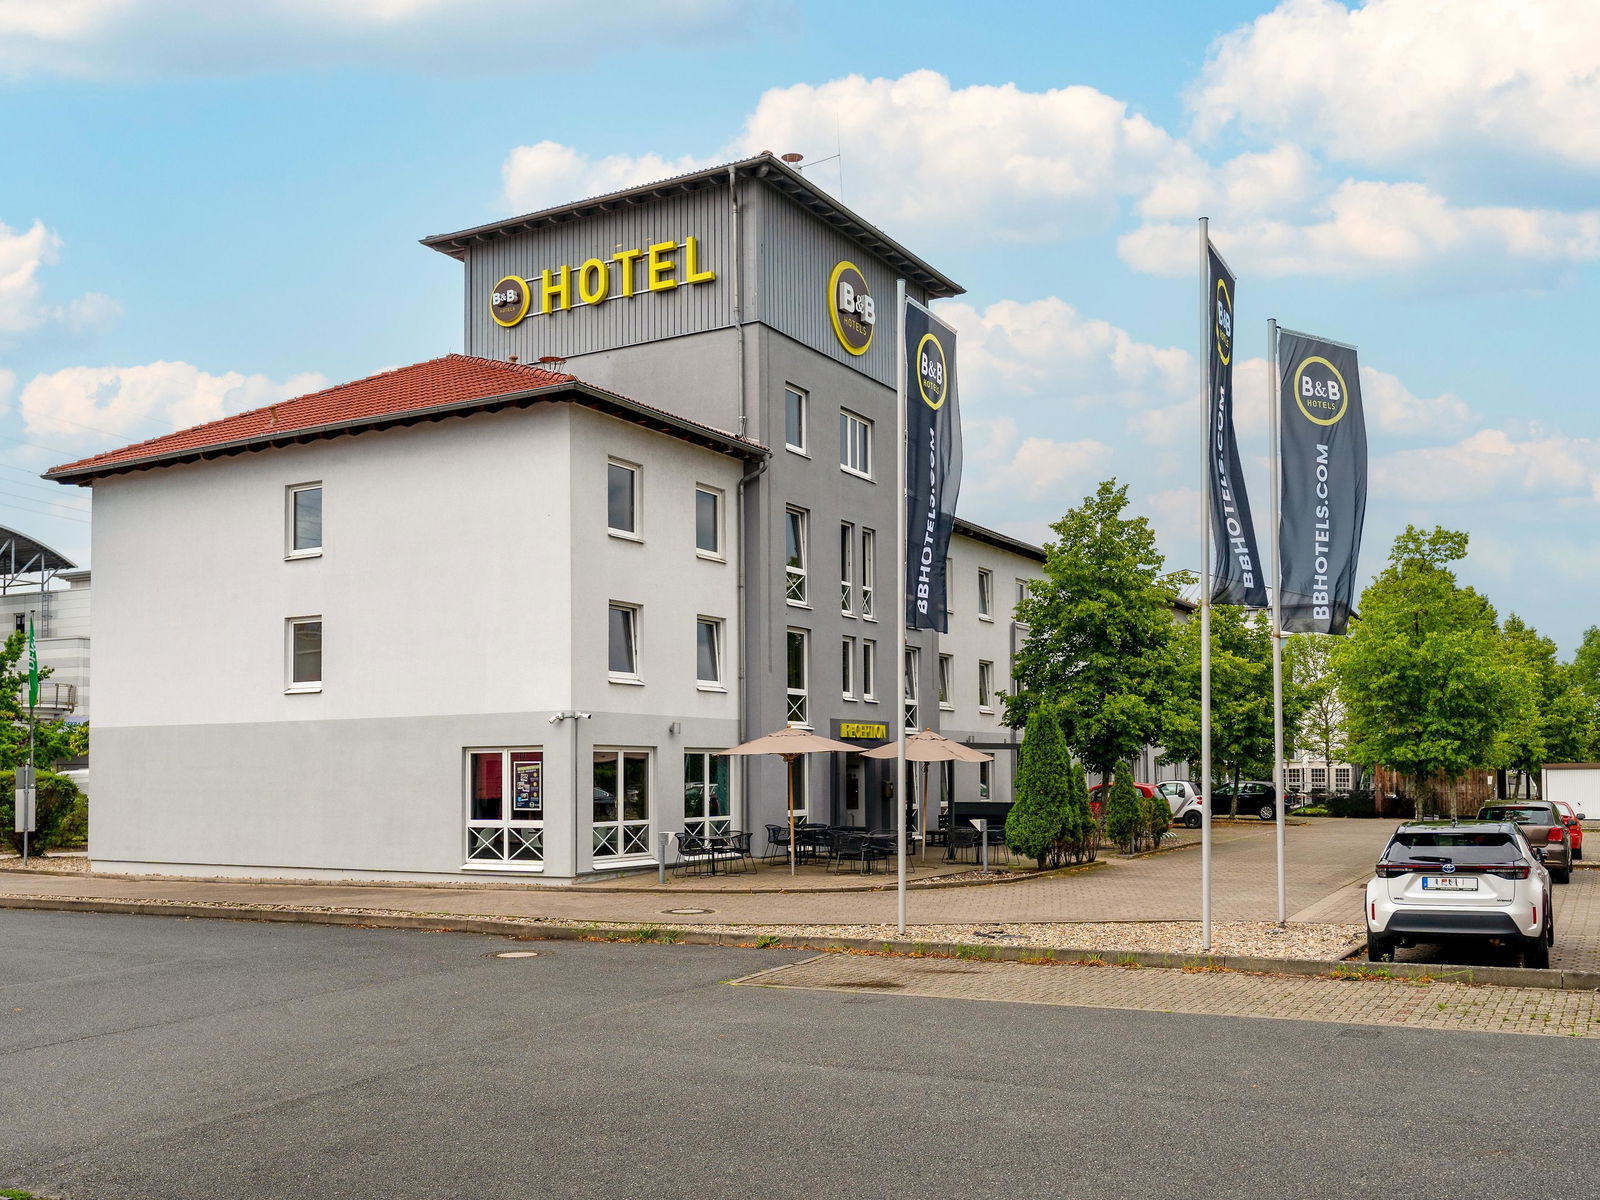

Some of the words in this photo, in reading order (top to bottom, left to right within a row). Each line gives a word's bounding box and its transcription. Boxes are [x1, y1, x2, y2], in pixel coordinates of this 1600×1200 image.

[542, 236, 716, 314] HOTEL
[492, 289, 518, 306] B&B
[840, 281, 876, 325] B&B
[843, 316, 867, 336] HOTELS
[921, 352, 943, 385] B&B
[923, 378, 940, 395] HOTELS
[1302, 375, 1341, 401] B&B
[1307, 399, 1336, 410] HOTELS
[1313, 443, 1330, 620] BBHOTELS.COM
[841, 723, 887, 739] RECEPTION
